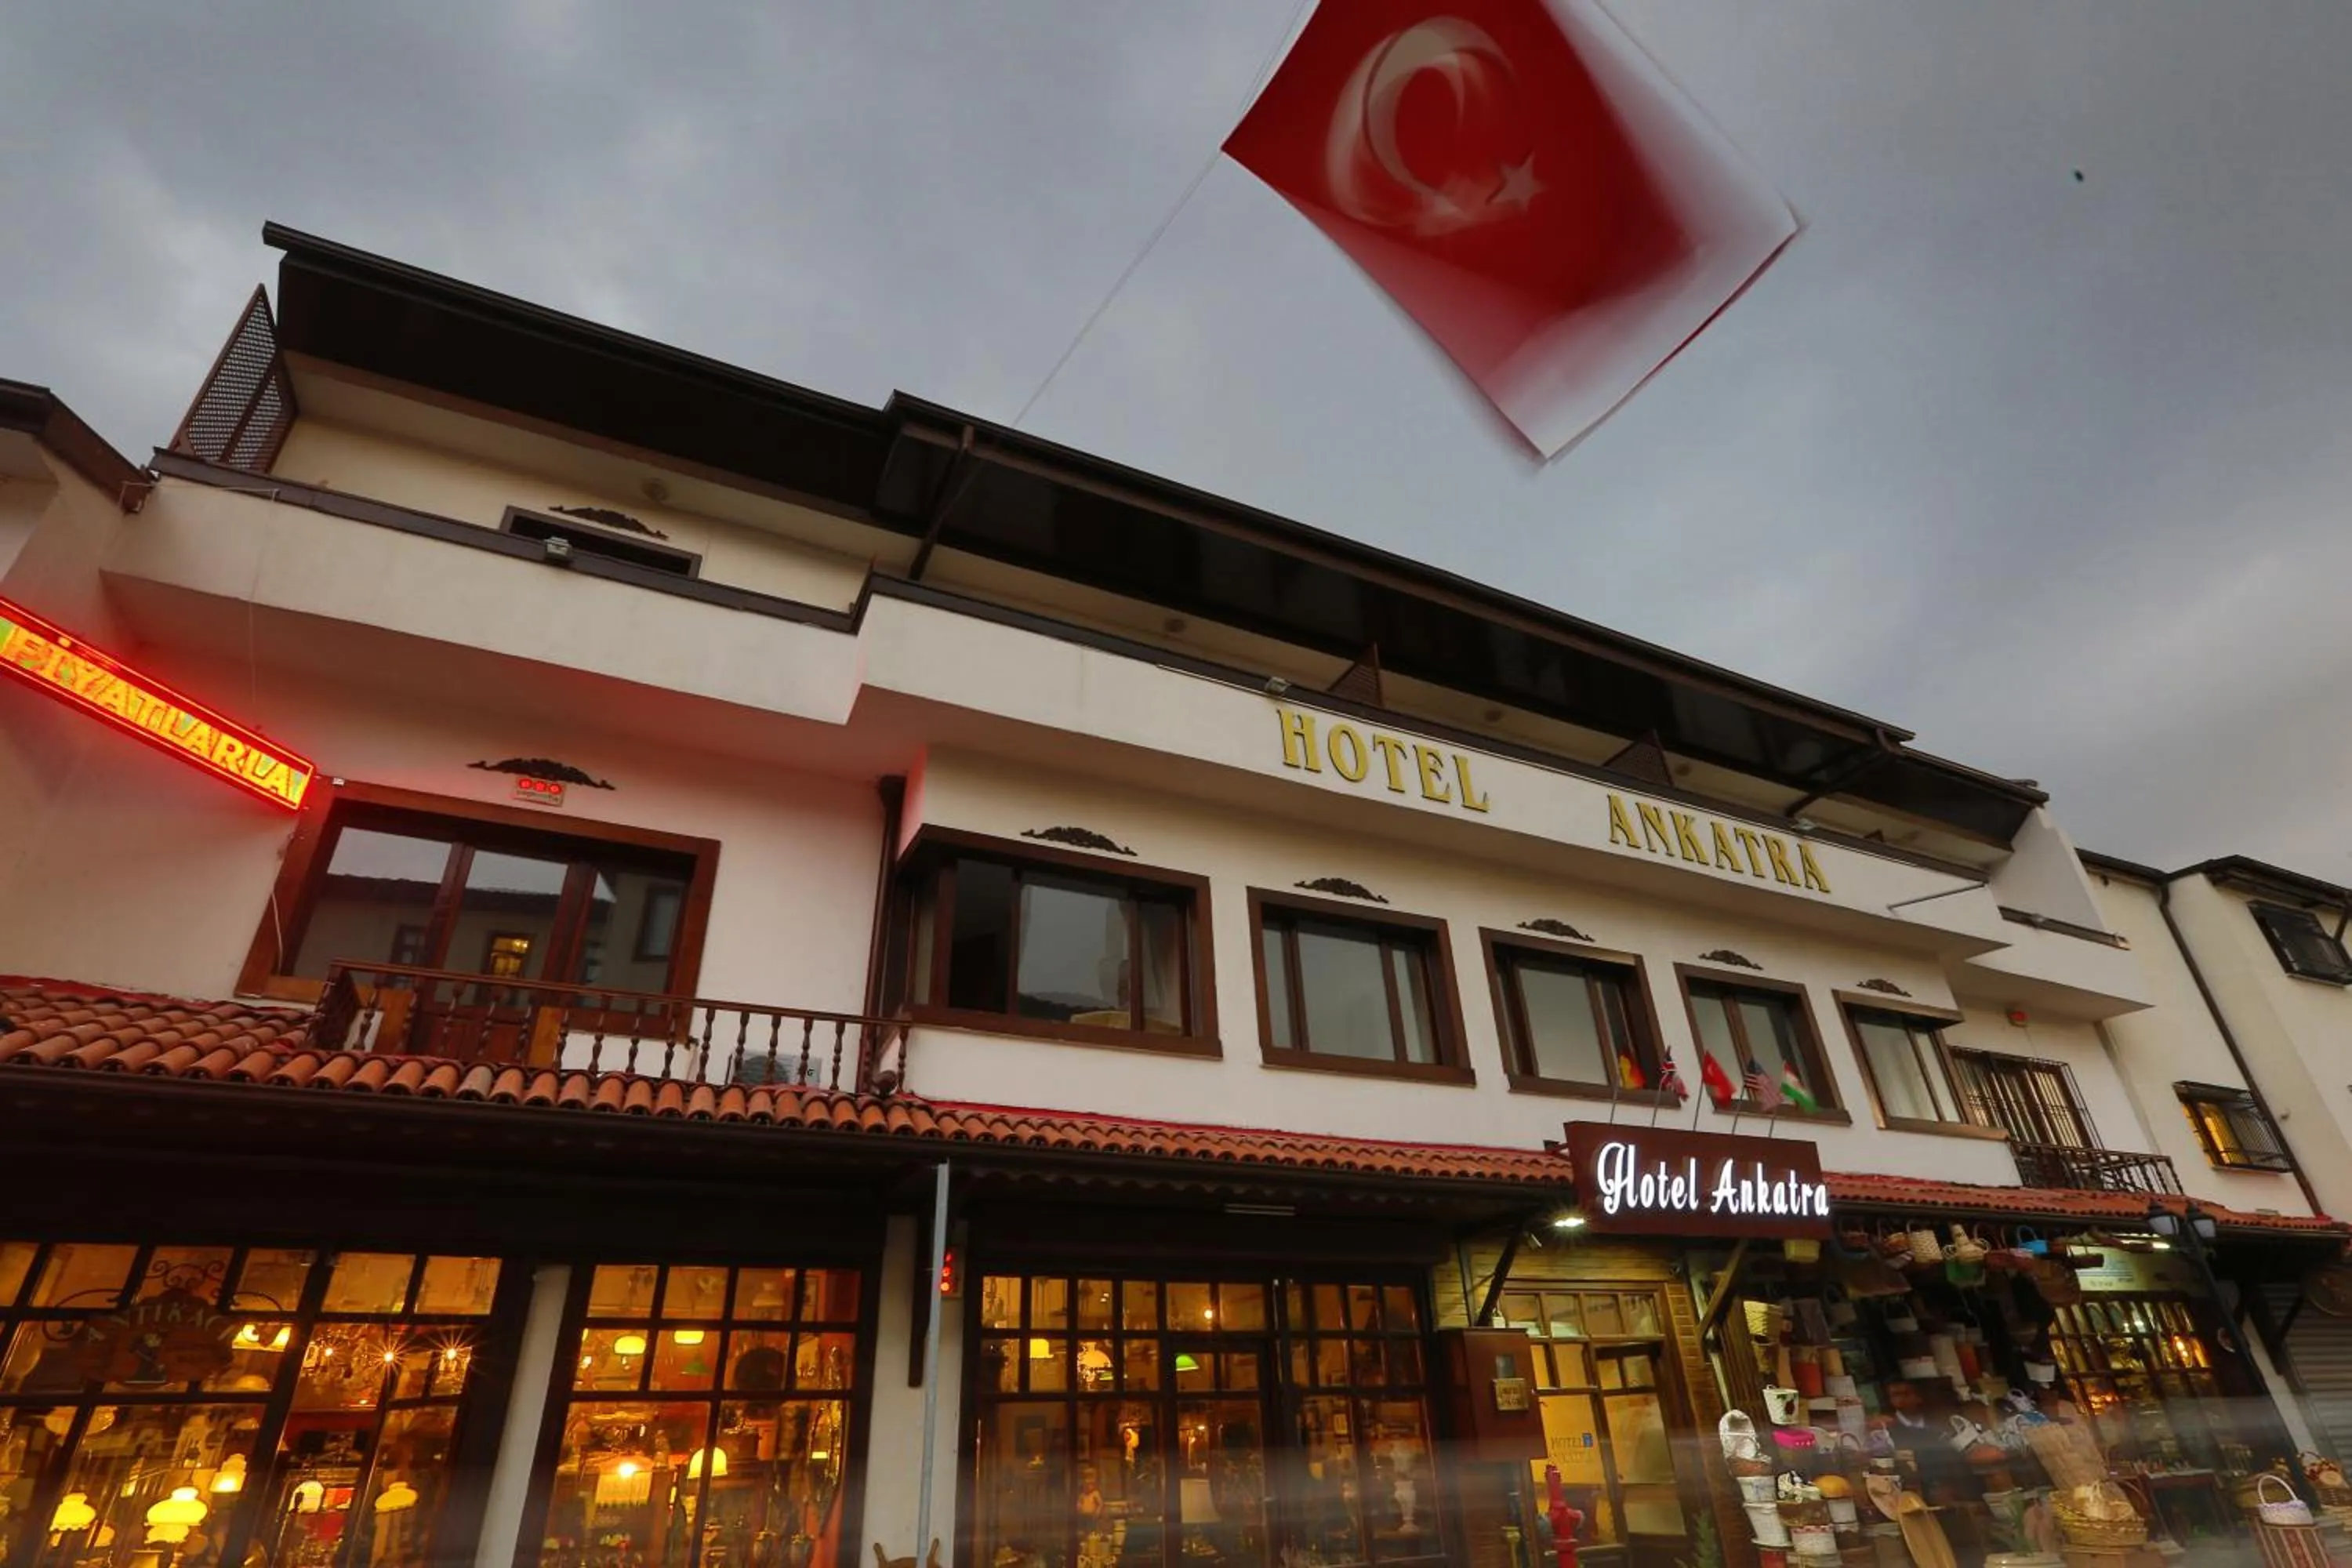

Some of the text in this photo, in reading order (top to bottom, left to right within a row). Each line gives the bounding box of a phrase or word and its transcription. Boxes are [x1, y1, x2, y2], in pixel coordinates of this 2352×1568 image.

[1276, 707, 1831, 894] HOTEL ANKATRA
[1597, 1142, 1830, 1216] Hotel Ankatra
